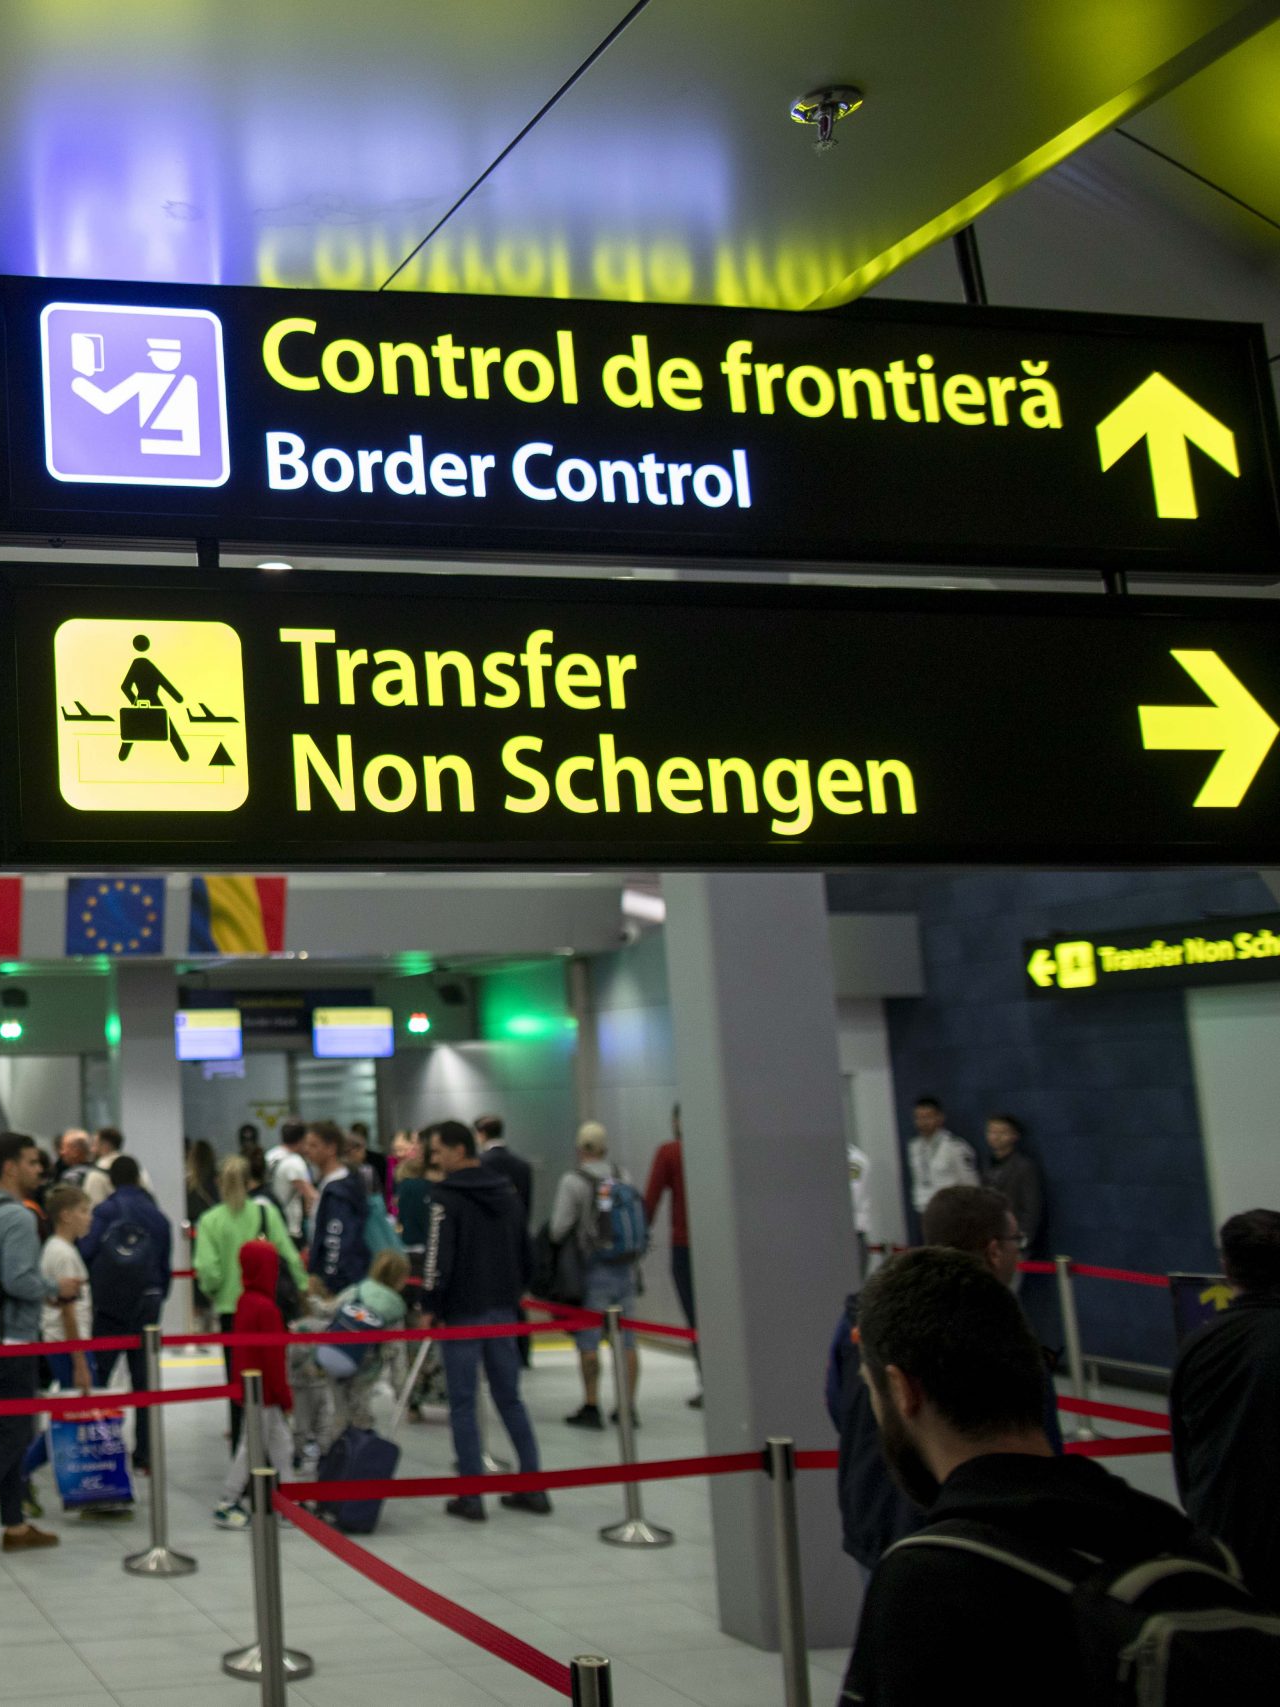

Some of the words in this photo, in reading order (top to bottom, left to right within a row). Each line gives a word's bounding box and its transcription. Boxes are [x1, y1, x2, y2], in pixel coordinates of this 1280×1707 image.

[262, 317, 579, 406] Control
[601, 334, 705, 412] de
[720, 339, 1063, 430] frontieră
[264, 429, 496, 499] Border
[511, 441, 753, 510] Control
[278, 626, 638, 711] Transfer
[291, 733, 477, 814] Non
[501, 733, 919, 837] Schengen
[1096, 940, 1183, 972] Transfer
[1182, 937, 1235, 964] Non
